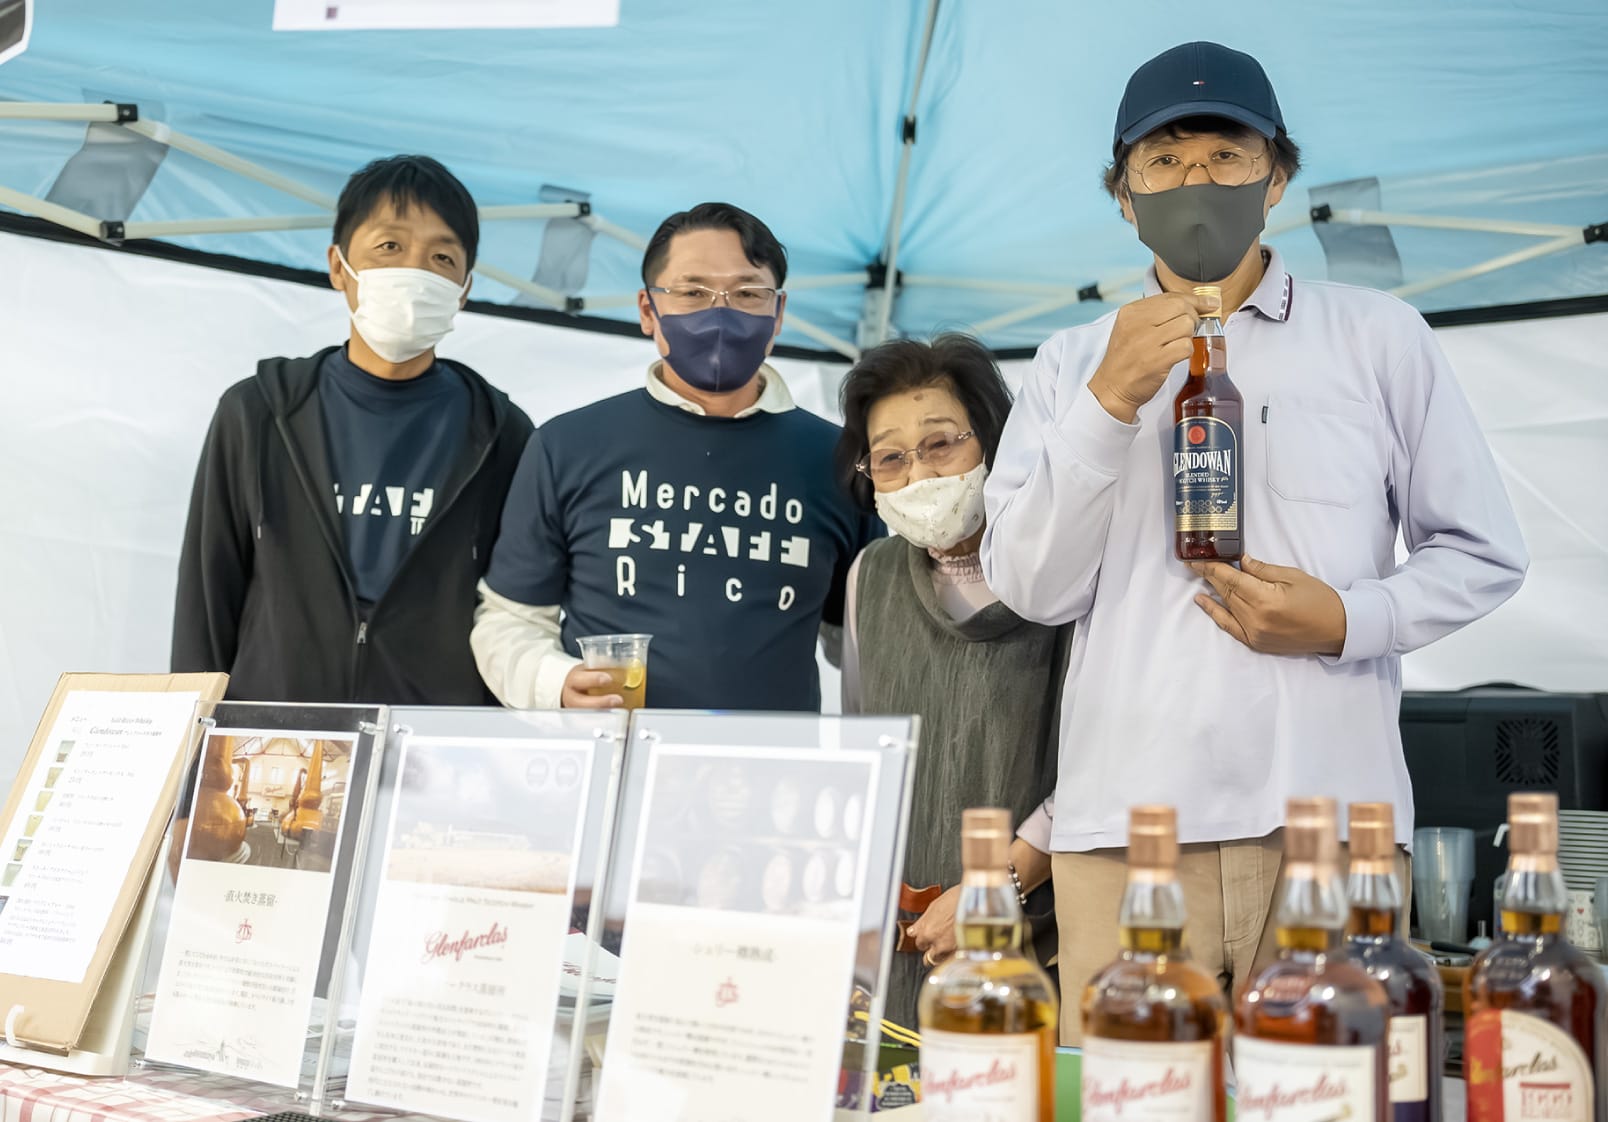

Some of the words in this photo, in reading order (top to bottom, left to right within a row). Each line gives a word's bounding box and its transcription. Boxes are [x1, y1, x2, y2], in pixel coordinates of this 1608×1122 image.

[622, 470, 804, 525] Mercado
[608, 517, 811, 569] STAFF
[616, 555, 796, 612] Rico
[421, 922, 508, 964] Glenfarclas
